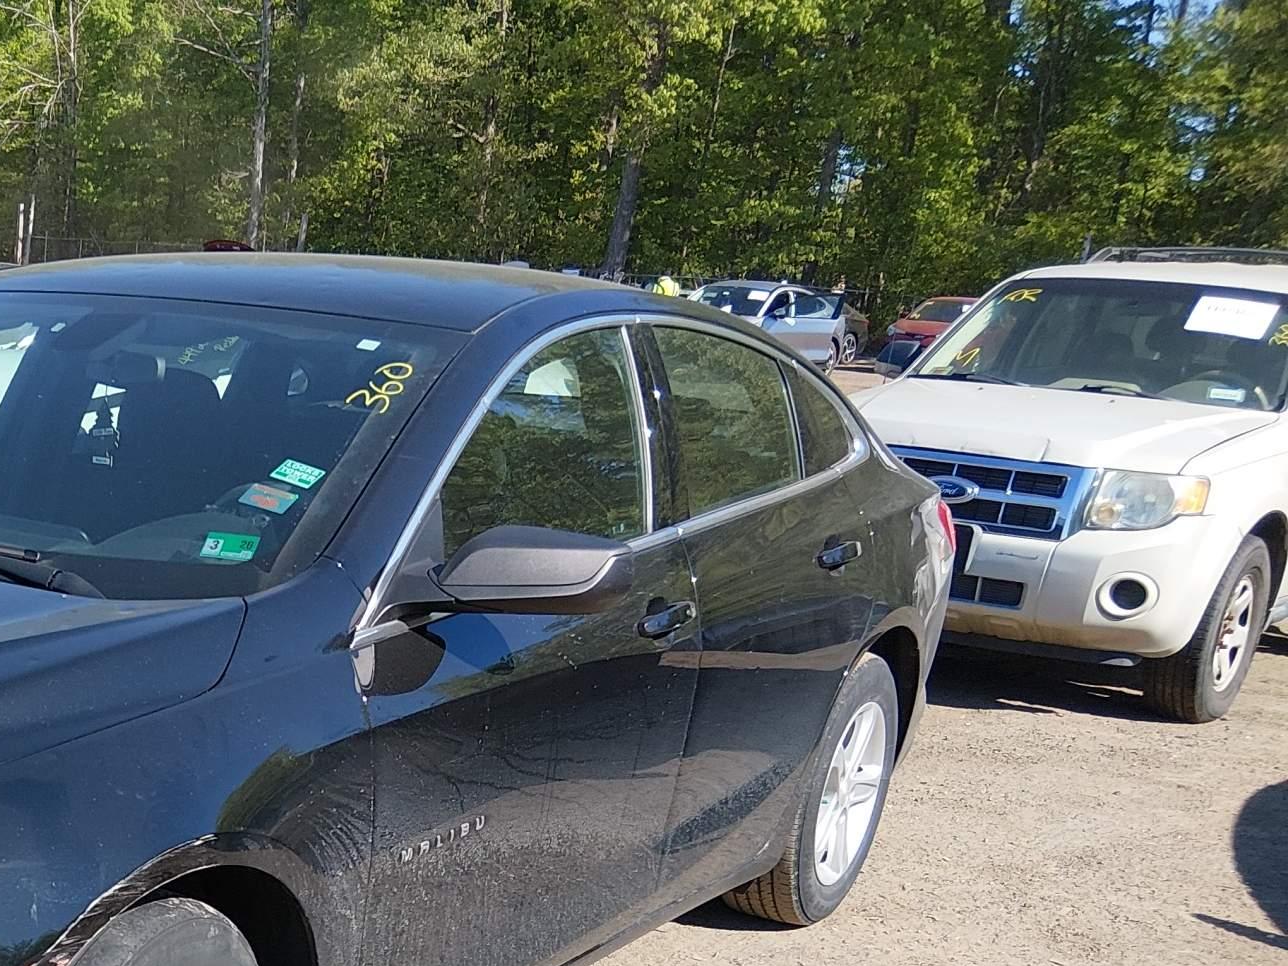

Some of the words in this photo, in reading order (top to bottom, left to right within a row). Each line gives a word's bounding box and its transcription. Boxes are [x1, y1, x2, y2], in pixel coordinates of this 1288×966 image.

[345, 362, 413, 413] 360
[209, 540, 221, 551] 3
[400, 815, 485, 864] MALIBU
